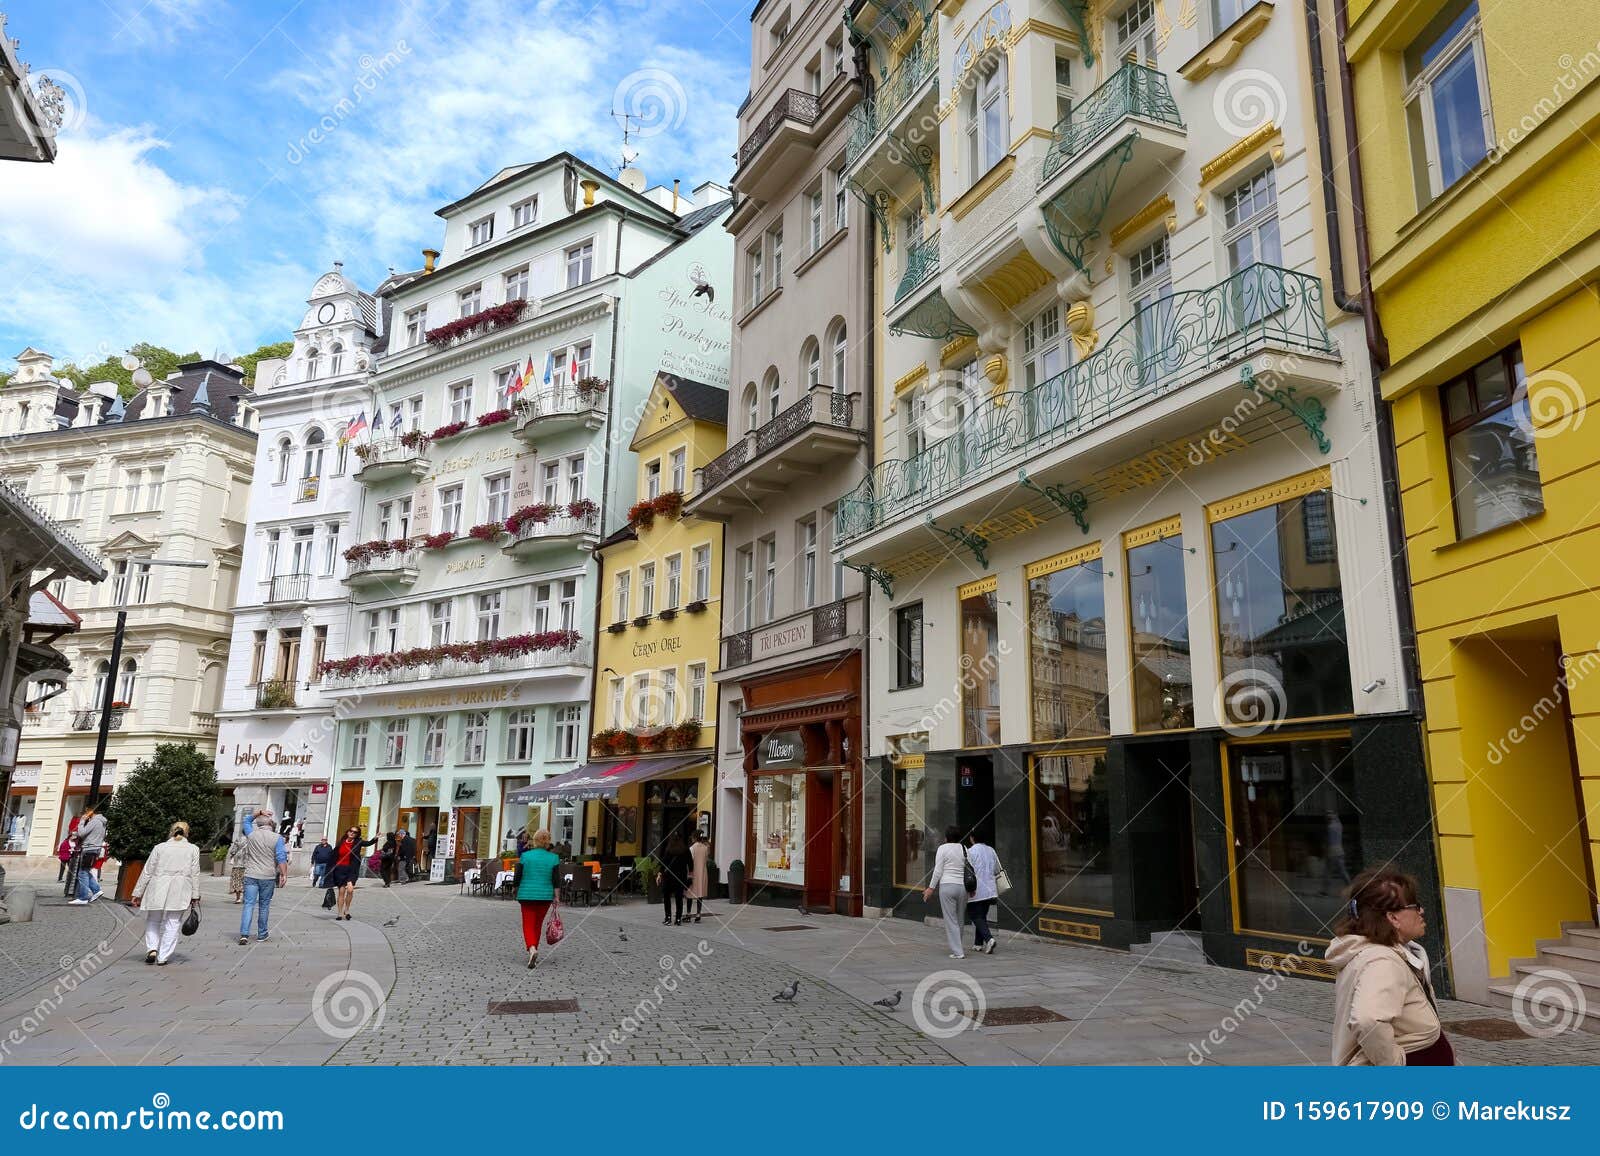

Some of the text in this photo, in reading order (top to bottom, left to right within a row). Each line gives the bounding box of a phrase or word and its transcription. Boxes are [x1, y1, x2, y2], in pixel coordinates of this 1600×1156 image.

[660, 636, 682, 653] OREL
[234, 743, 313, 770] baby Glamour
[767, 739, 795, 764] Moser
[448, 807, 458, 857] EXCHANGE
